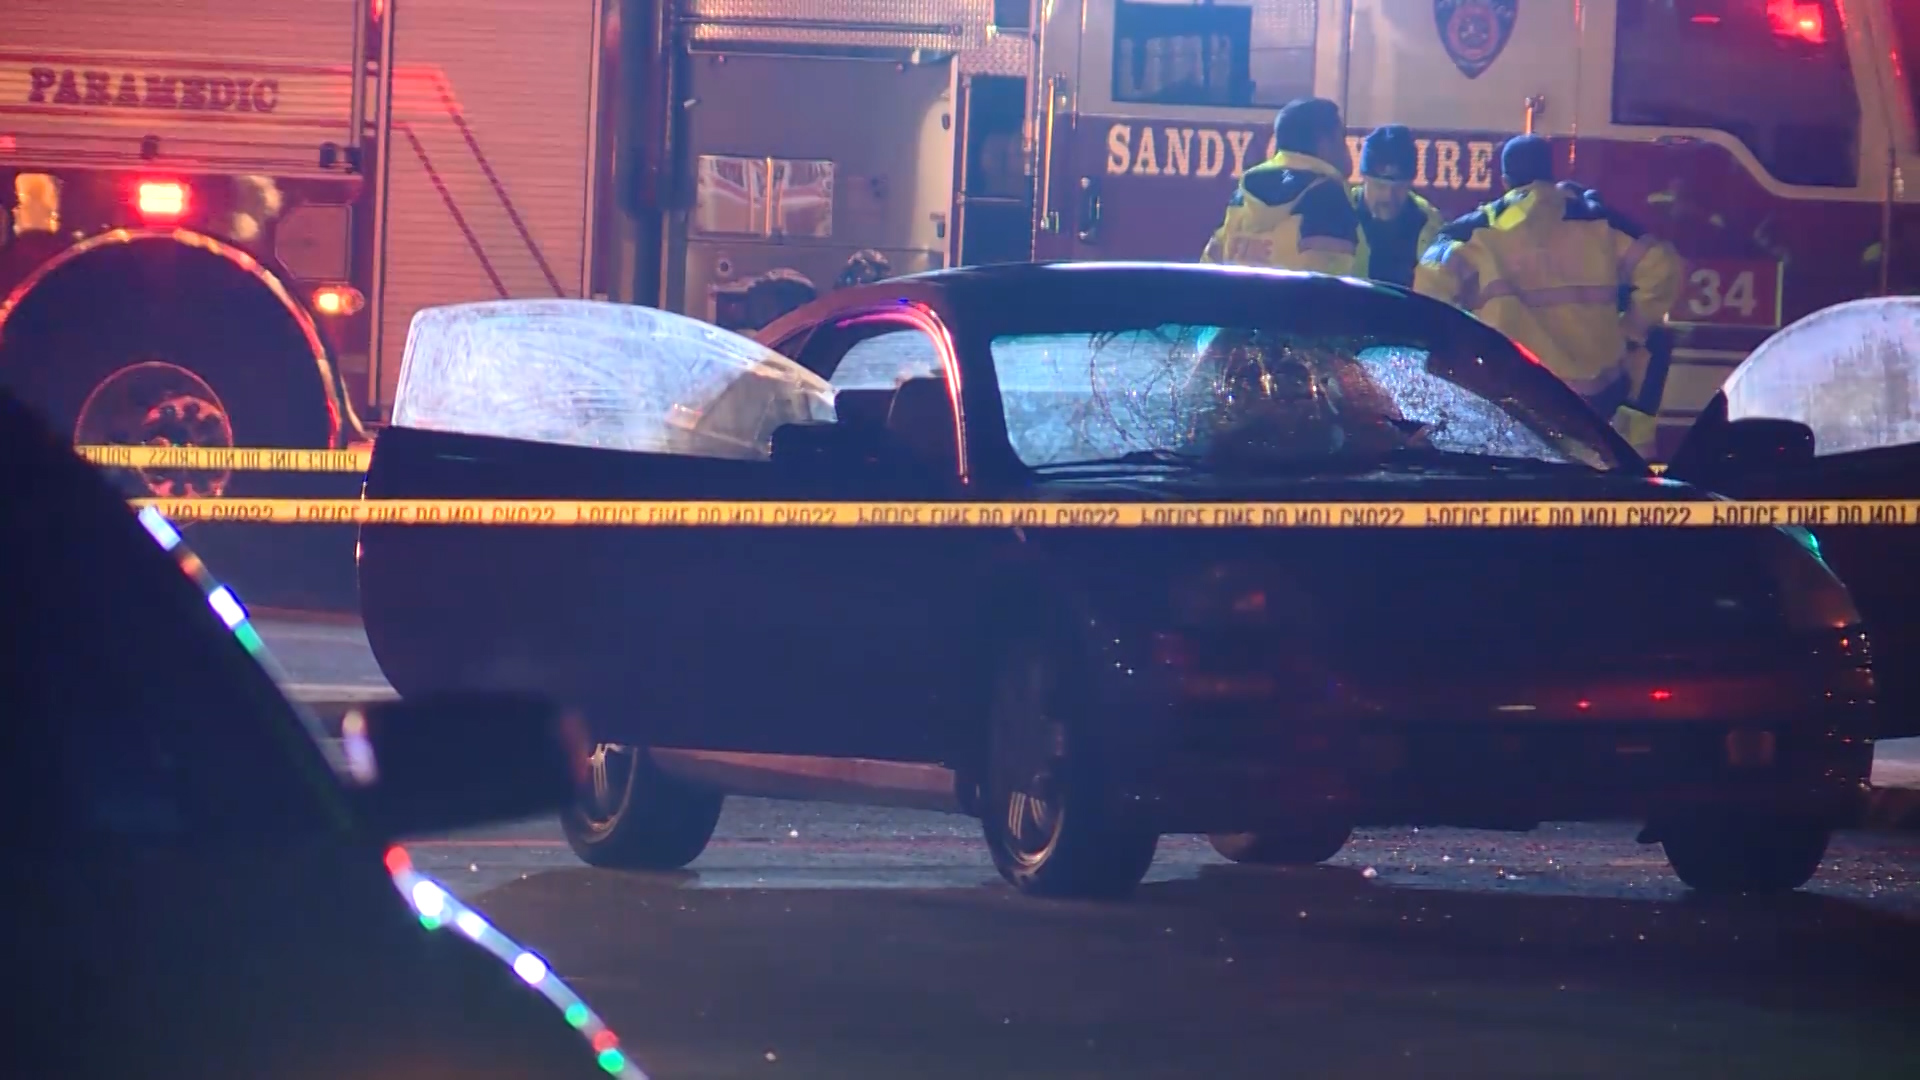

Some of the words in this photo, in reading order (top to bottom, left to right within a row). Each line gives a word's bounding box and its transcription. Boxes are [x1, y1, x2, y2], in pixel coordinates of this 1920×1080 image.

[29, 67, 279, 113] PARAMEDIC
[1107, 124, 1254, 178] SANDY
[1412, 138, 1494, 190] IRE
[1689, 269, 1757, 317] 34
